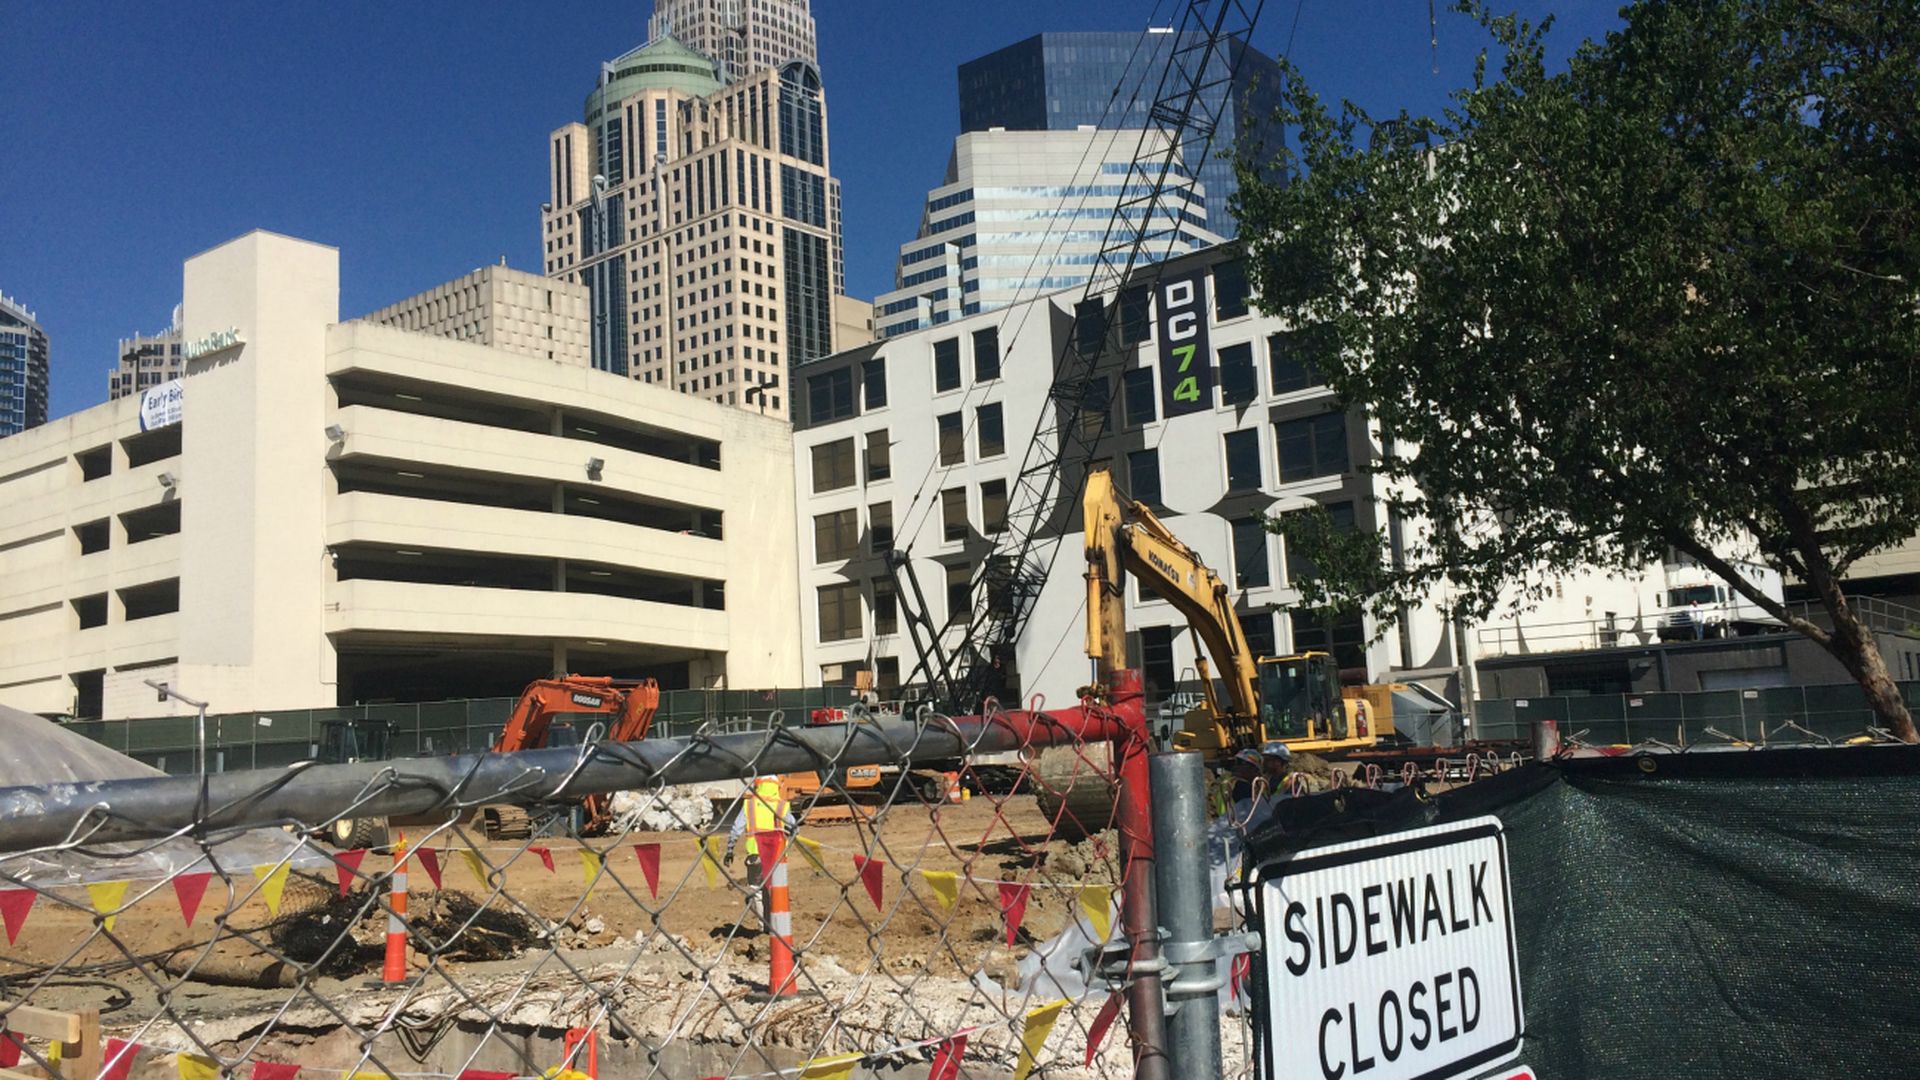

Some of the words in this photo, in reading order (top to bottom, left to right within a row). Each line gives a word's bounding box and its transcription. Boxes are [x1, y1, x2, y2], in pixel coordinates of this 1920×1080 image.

[148, 391, 168, 410] Early
[1149, 550, 1180, 584] KOMATSU
[573, 694, 602, 707] DOOSAN
[850, 768, 878, 778] CASE
[1284, 861, 1493, 977] SIDEWALK
[1318, 966, 1481, 1080] CLOSED
